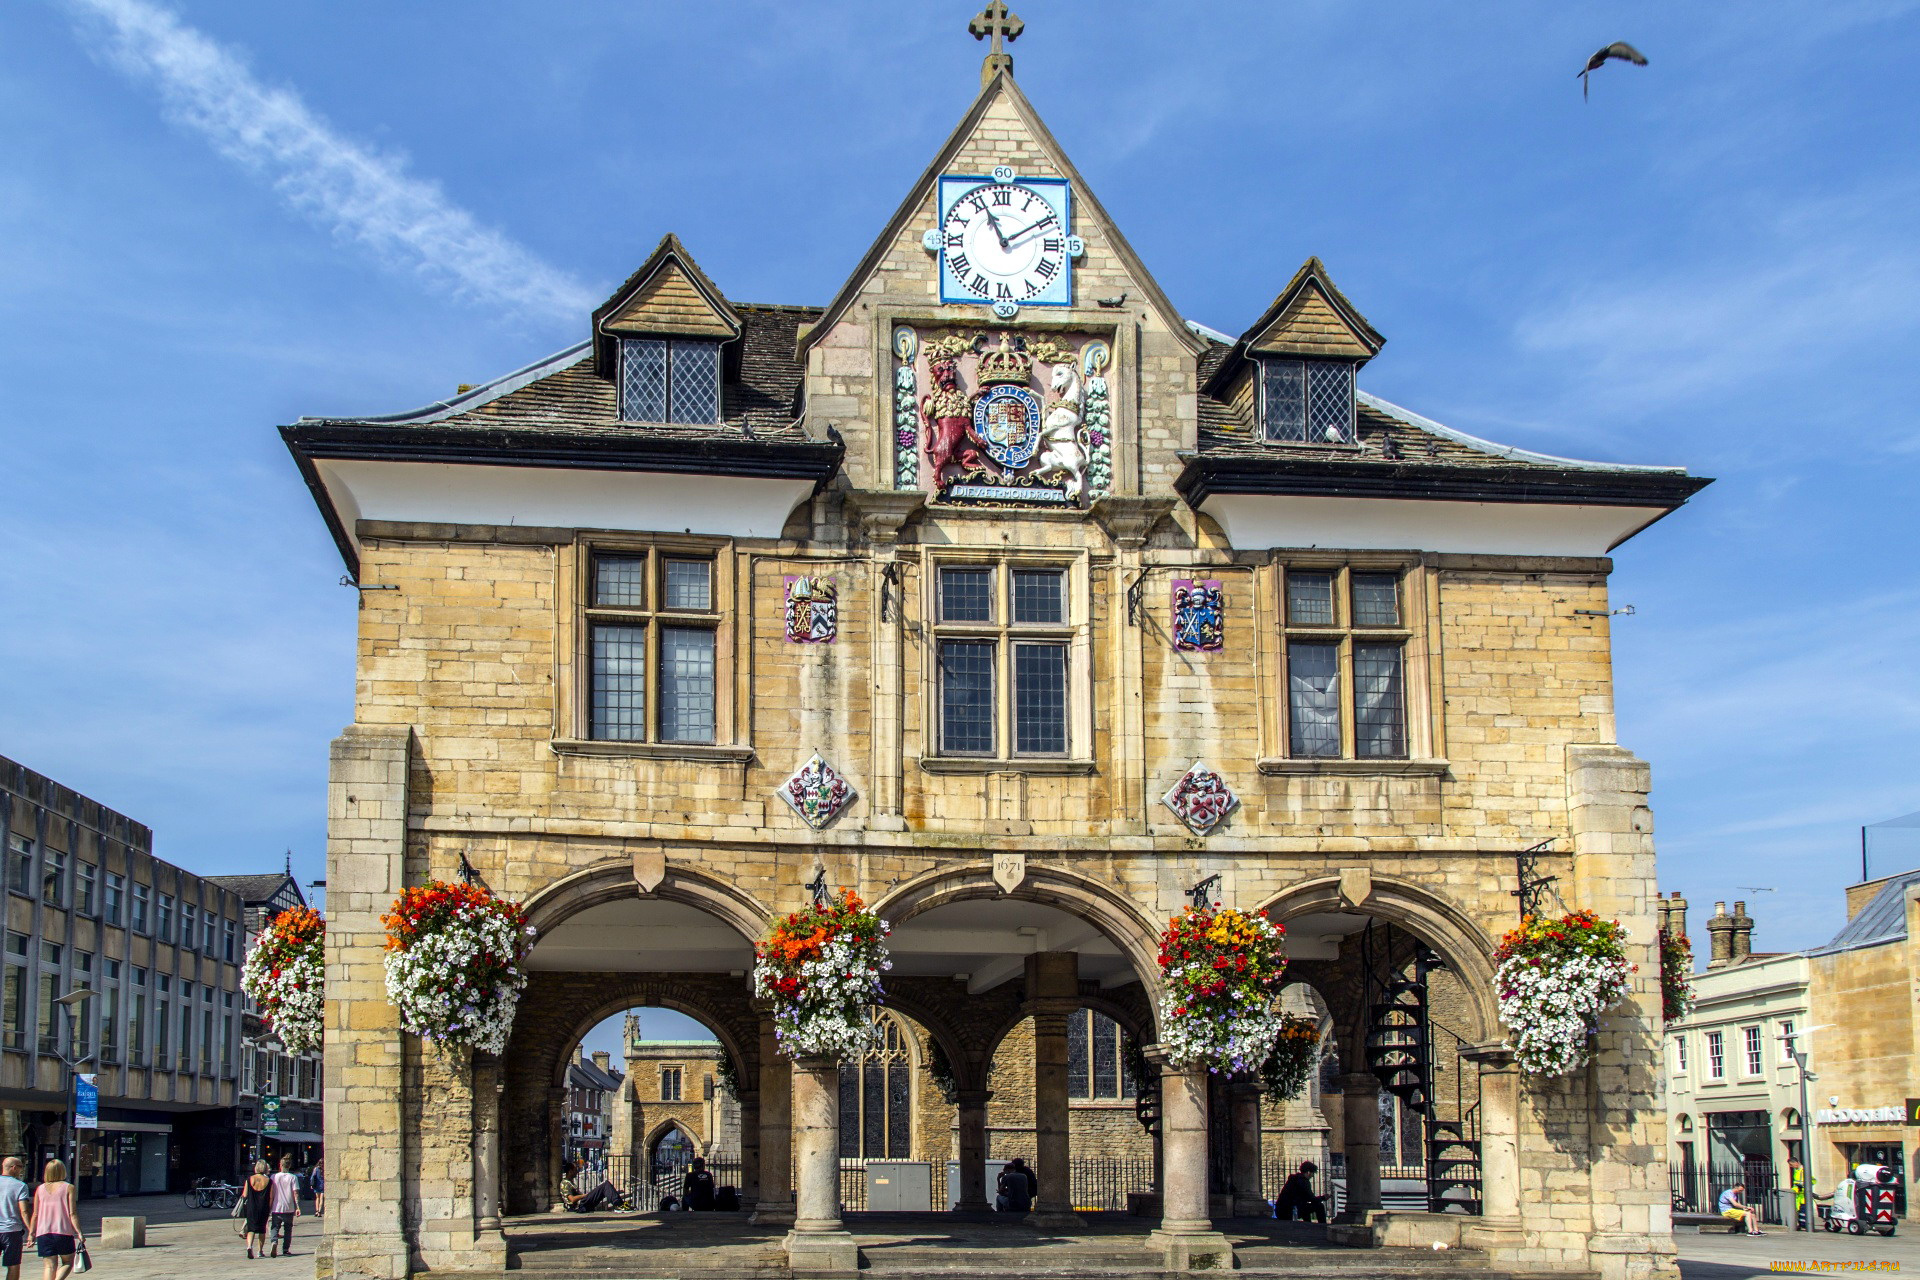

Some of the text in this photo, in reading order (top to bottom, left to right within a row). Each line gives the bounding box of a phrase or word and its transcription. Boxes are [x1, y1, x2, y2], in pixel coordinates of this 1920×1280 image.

[994, 167, 1012, 179] 60
[968, 195, 988, 214] XI
[992, 191, 1011, 206] XII
[1021, 197, 1033, 213] I
[952, 213, 970, 228] X
[927, 234, 942, 245] 45
[948, 233, 964, 248] IX
[1043, 238, 1059, 253] III
[1068, 240, 1080, 251] 15
[950, 252, 972, 280] VIII
[970, 273, 989, 295] VII
[996, 283, 1013, 298] VI
[1024, 279, 1037, 294] V
[998, 305, 1014, 315] 30
[975, 399, 987, 424] HONI
[991, 387, 1021, 397] SOIT
[1024, 396, 1037, 415] QVI
[986, 488, 1000, 498] ET
[1004, 489, 1027, 499] MON
[1029, 490, 1062, 500] DROIT
[997, 857, 1020, 874] 1671
